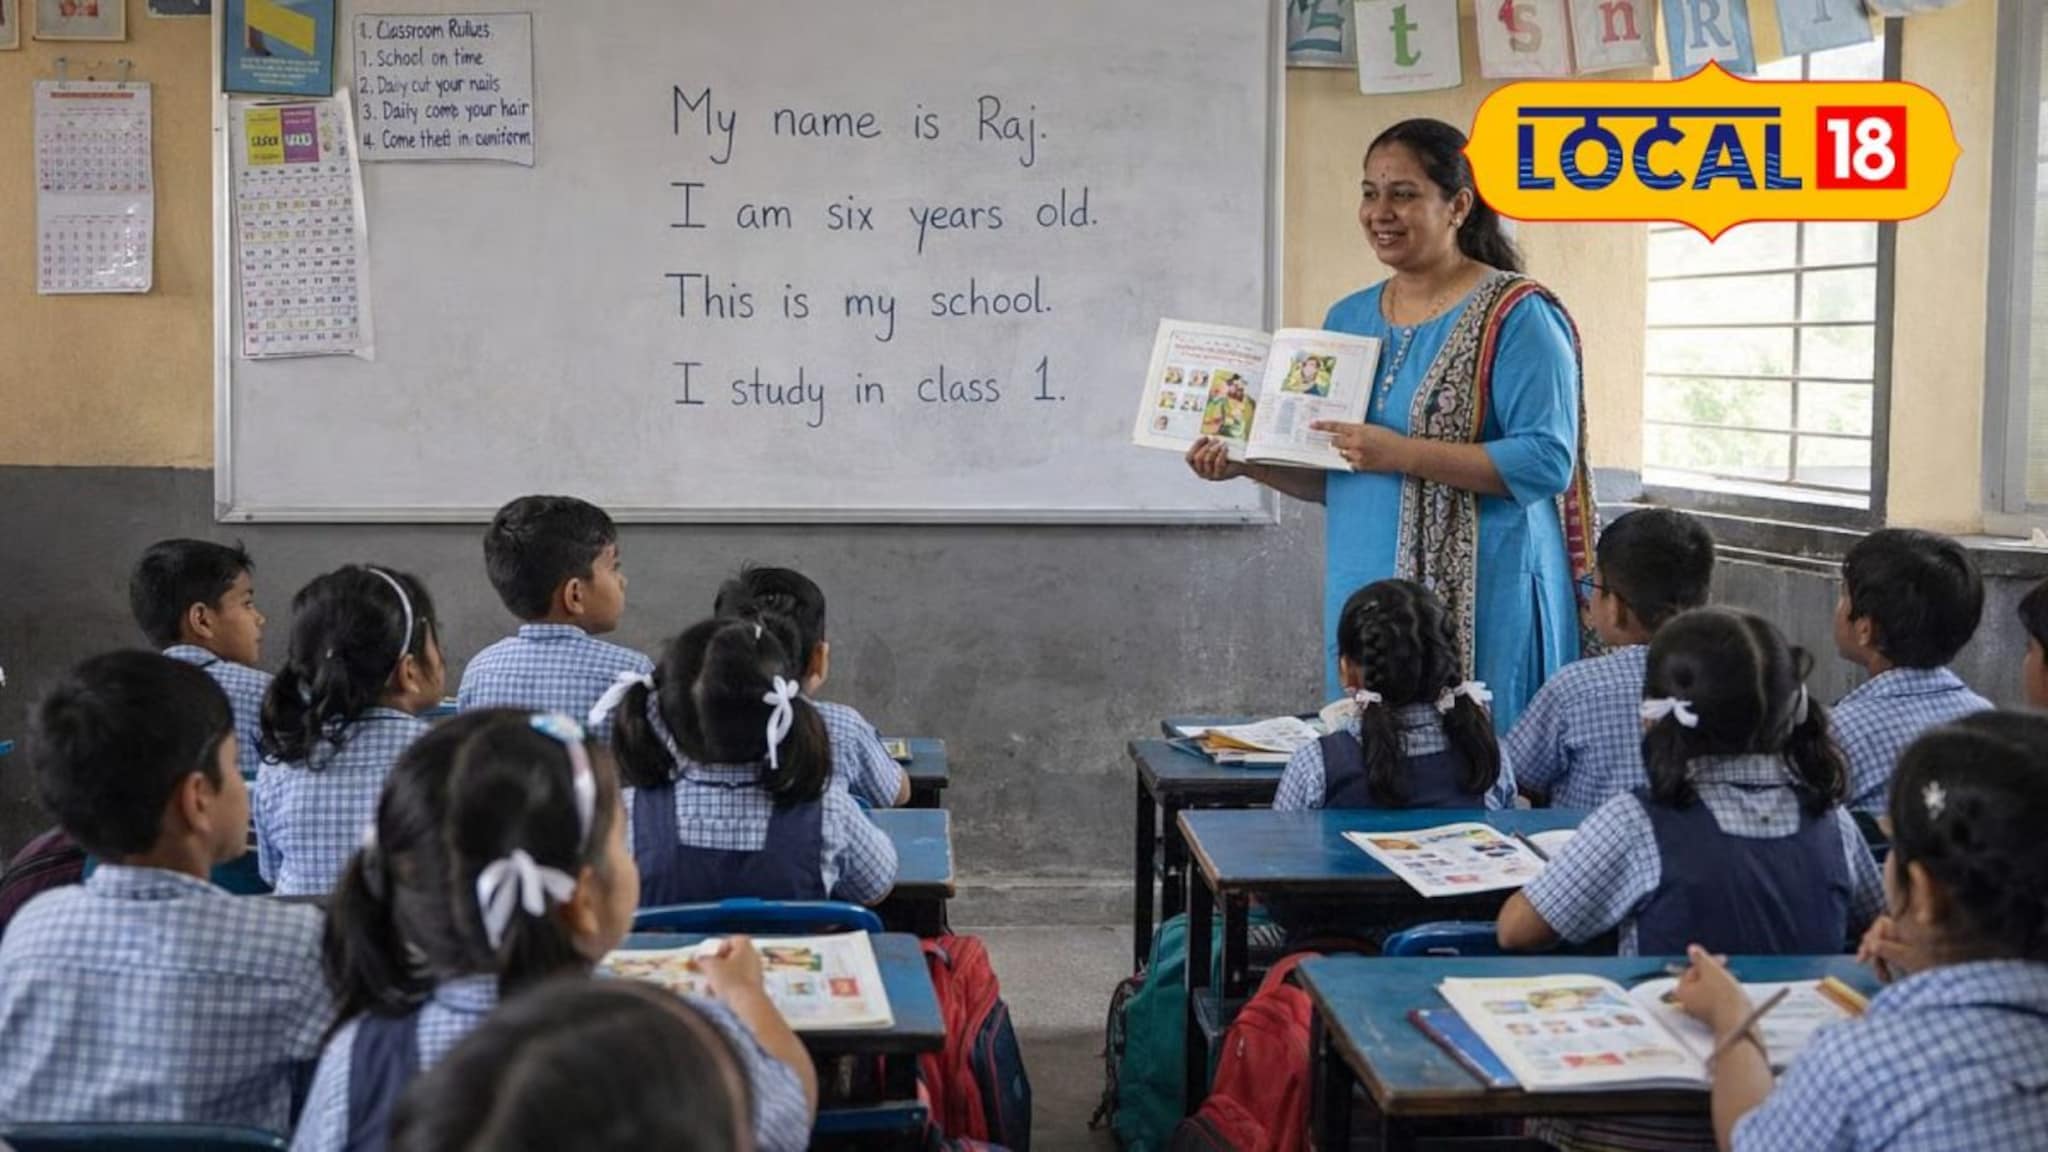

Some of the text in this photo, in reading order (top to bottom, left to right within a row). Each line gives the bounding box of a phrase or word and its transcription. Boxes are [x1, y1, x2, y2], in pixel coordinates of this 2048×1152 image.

[378, 46, 423, 67] School
[431, 54, 448, 66] on
[454, 47, 484, 66] time
[360, 77, 374, 94] 2.
[412, 77, 431, 93] cut
[435, 79, 463, 98] your
[470, 74, 500, 92] nails
[363, 103, 377, 121] 3.
[383, 101, 418, 124] Daily
[465, 104, 497, 122] your
[500, 98, 529, 117] hair
[673, 84, 1047, 167] My name is Raj.
[382, 130, 416, 149] Come
[459, 130, 469, 146] in
[670, 182, 1098, 255] I am six years old.
[664, 273, 1052, 342] This is my school.
[673, 356, 1066, 428] I study in class 1.
